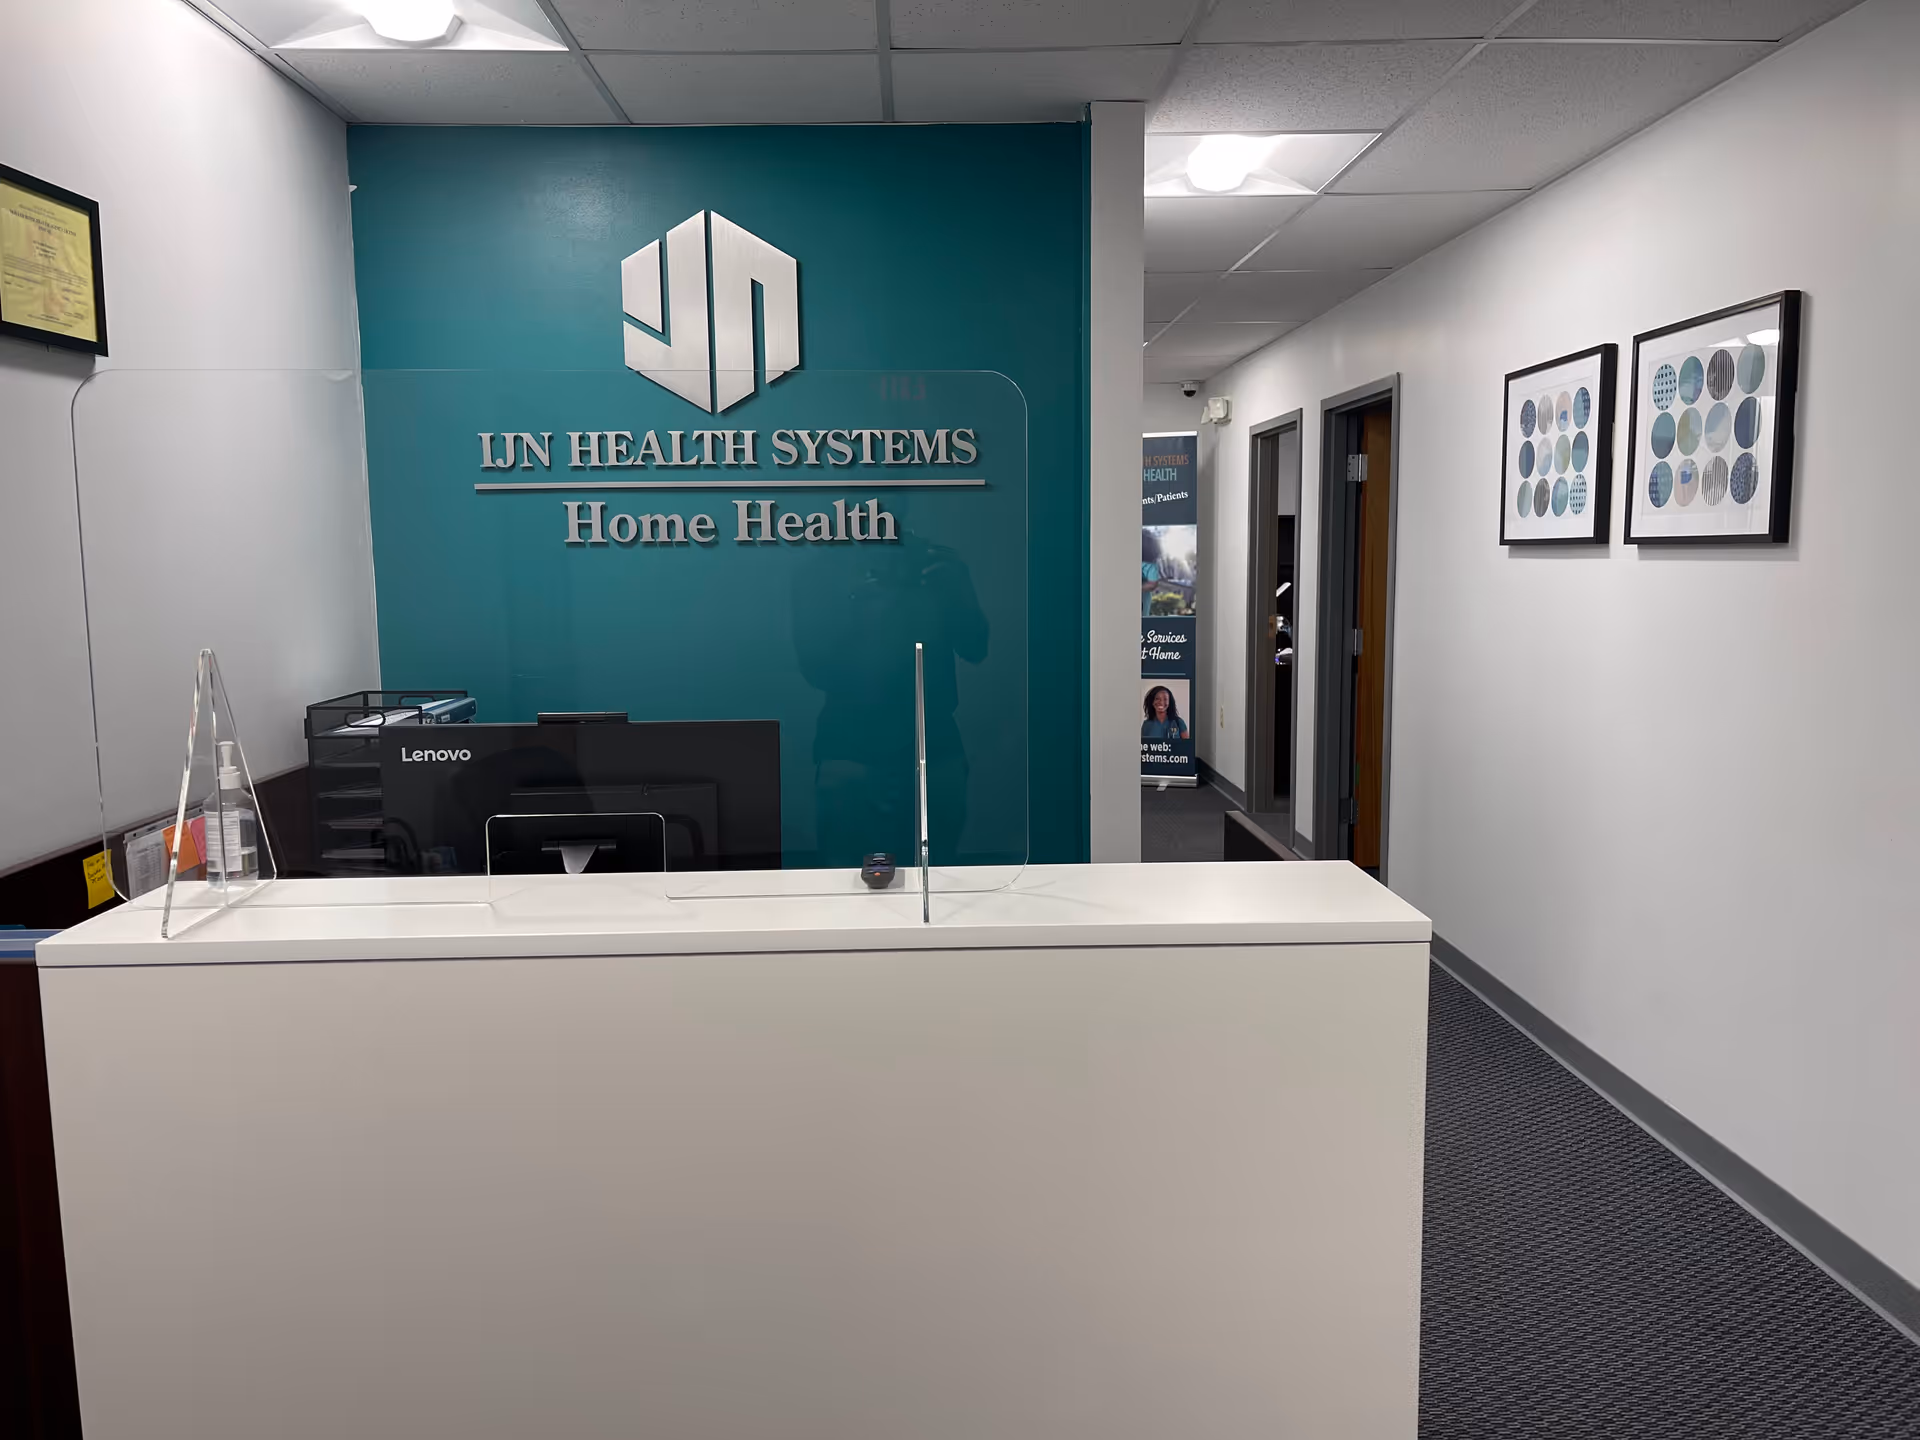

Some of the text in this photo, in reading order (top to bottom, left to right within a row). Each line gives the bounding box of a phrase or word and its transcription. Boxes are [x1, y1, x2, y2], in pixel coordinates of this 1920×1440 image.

[477, 428, 978, 469] IJN HEALTH SYSTEMS
[1153, 453, 1189, 466] SYSTEMS
[1143, 467, 1177, 482] HEALTH
[563, 498, 898, 544] Home Health
[1147, 629, 1188, 643] Services
[1148, 646, 1182, 660] Home
[1150, 741, 1172, 752] web:
[401, 747, 472, 762] Lenovo
[1141, 753, 1189, 764] stems.com
